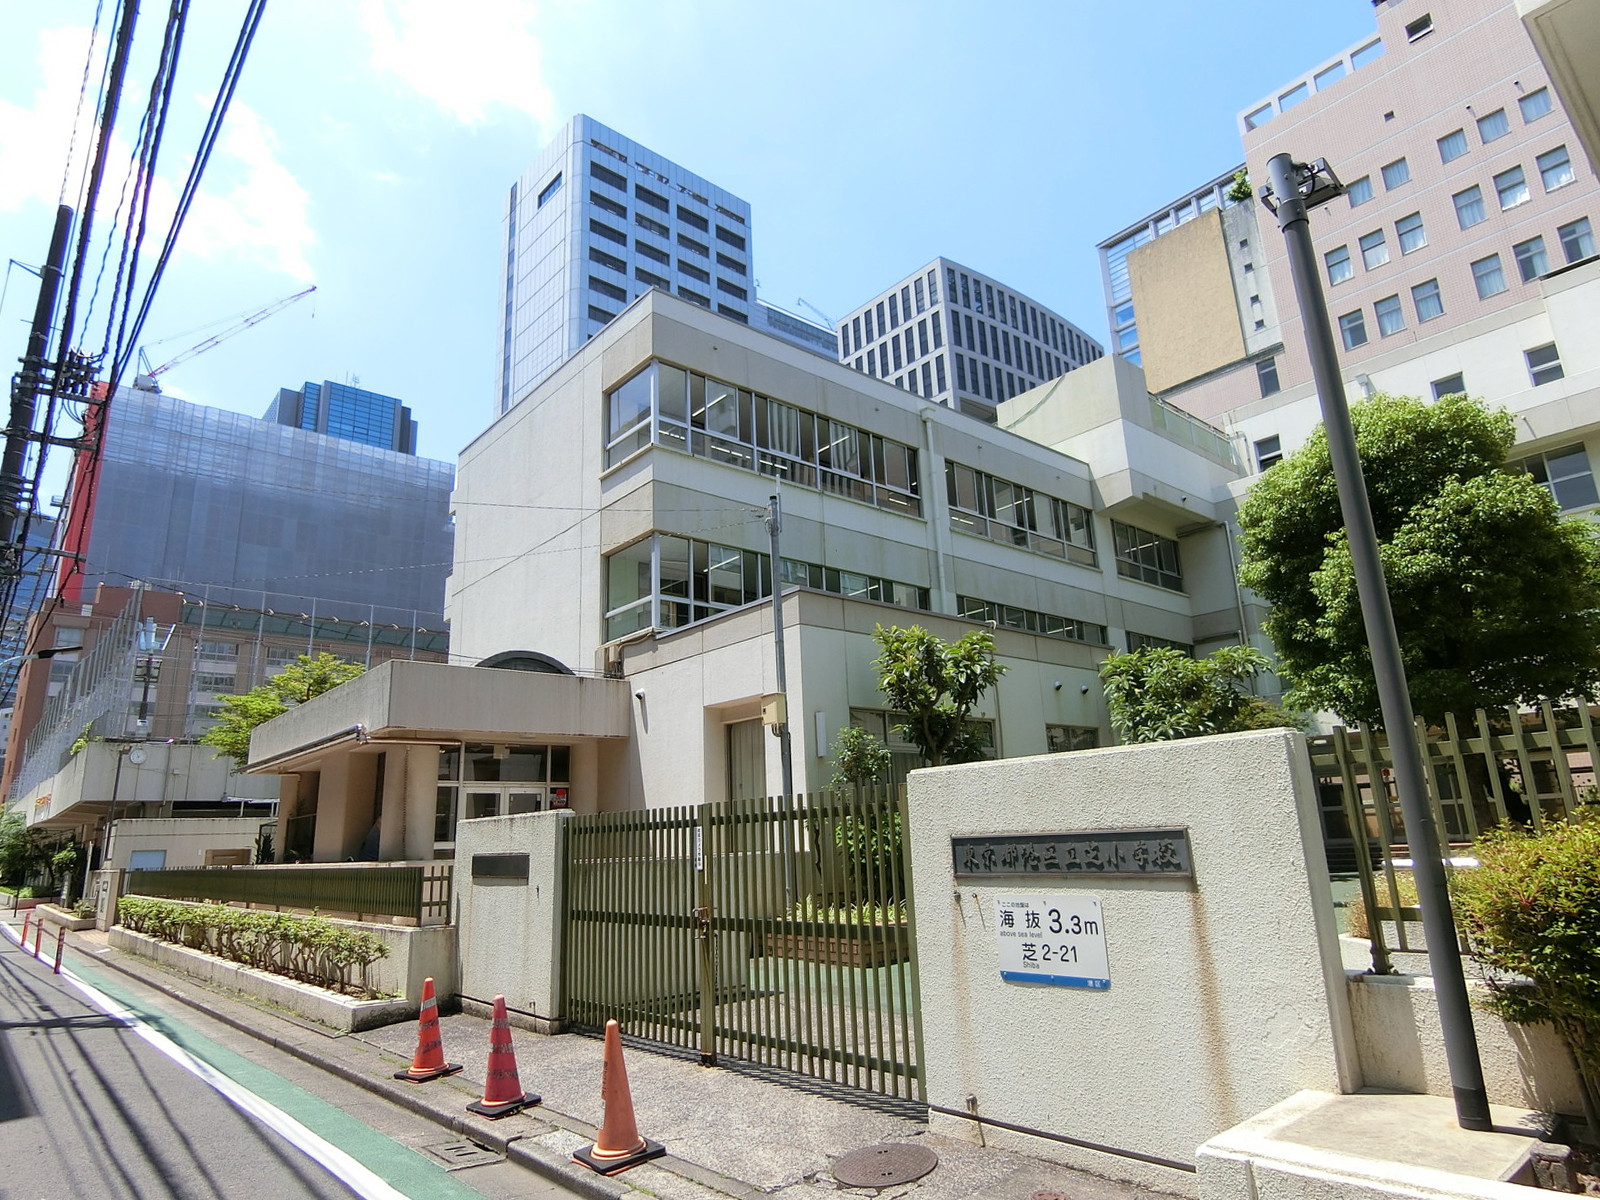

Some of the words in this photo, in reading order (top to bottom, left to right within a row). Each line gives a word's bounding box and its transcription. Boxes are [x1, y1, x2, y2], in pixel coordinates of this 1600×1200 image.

[964, 839, 1181, 870] 東京都港区立芝小学校
[1048, 908, 1099, 935] 3.3m
[1023, 961, 1040, 969] Shiba
